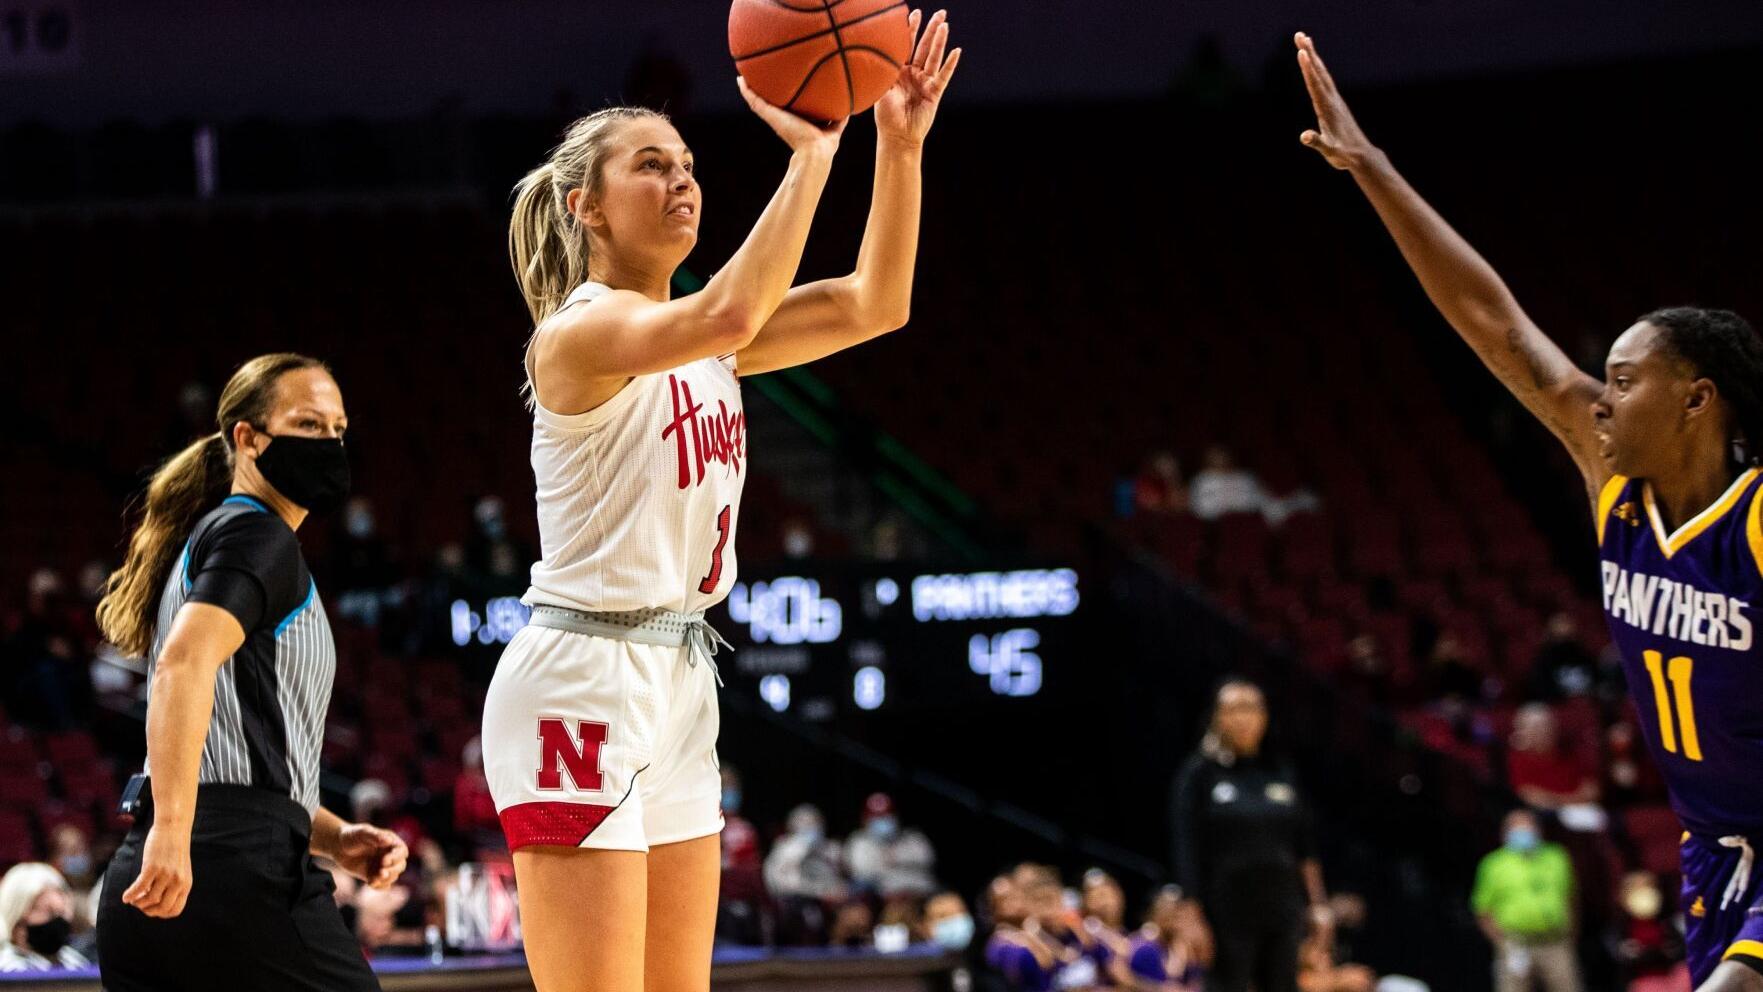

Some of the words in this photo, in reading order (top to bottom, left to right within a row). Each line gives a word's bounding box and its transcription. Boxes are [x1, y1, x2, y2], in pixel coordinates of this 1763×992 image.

[698, 504, 731, 594] 1
[1600, 559, 1753, 652] PANTHERS
[968, 628, 1043, 697] 45
[1642, 648, 1704, 762] 11
[536, 717, 609, 792] N
